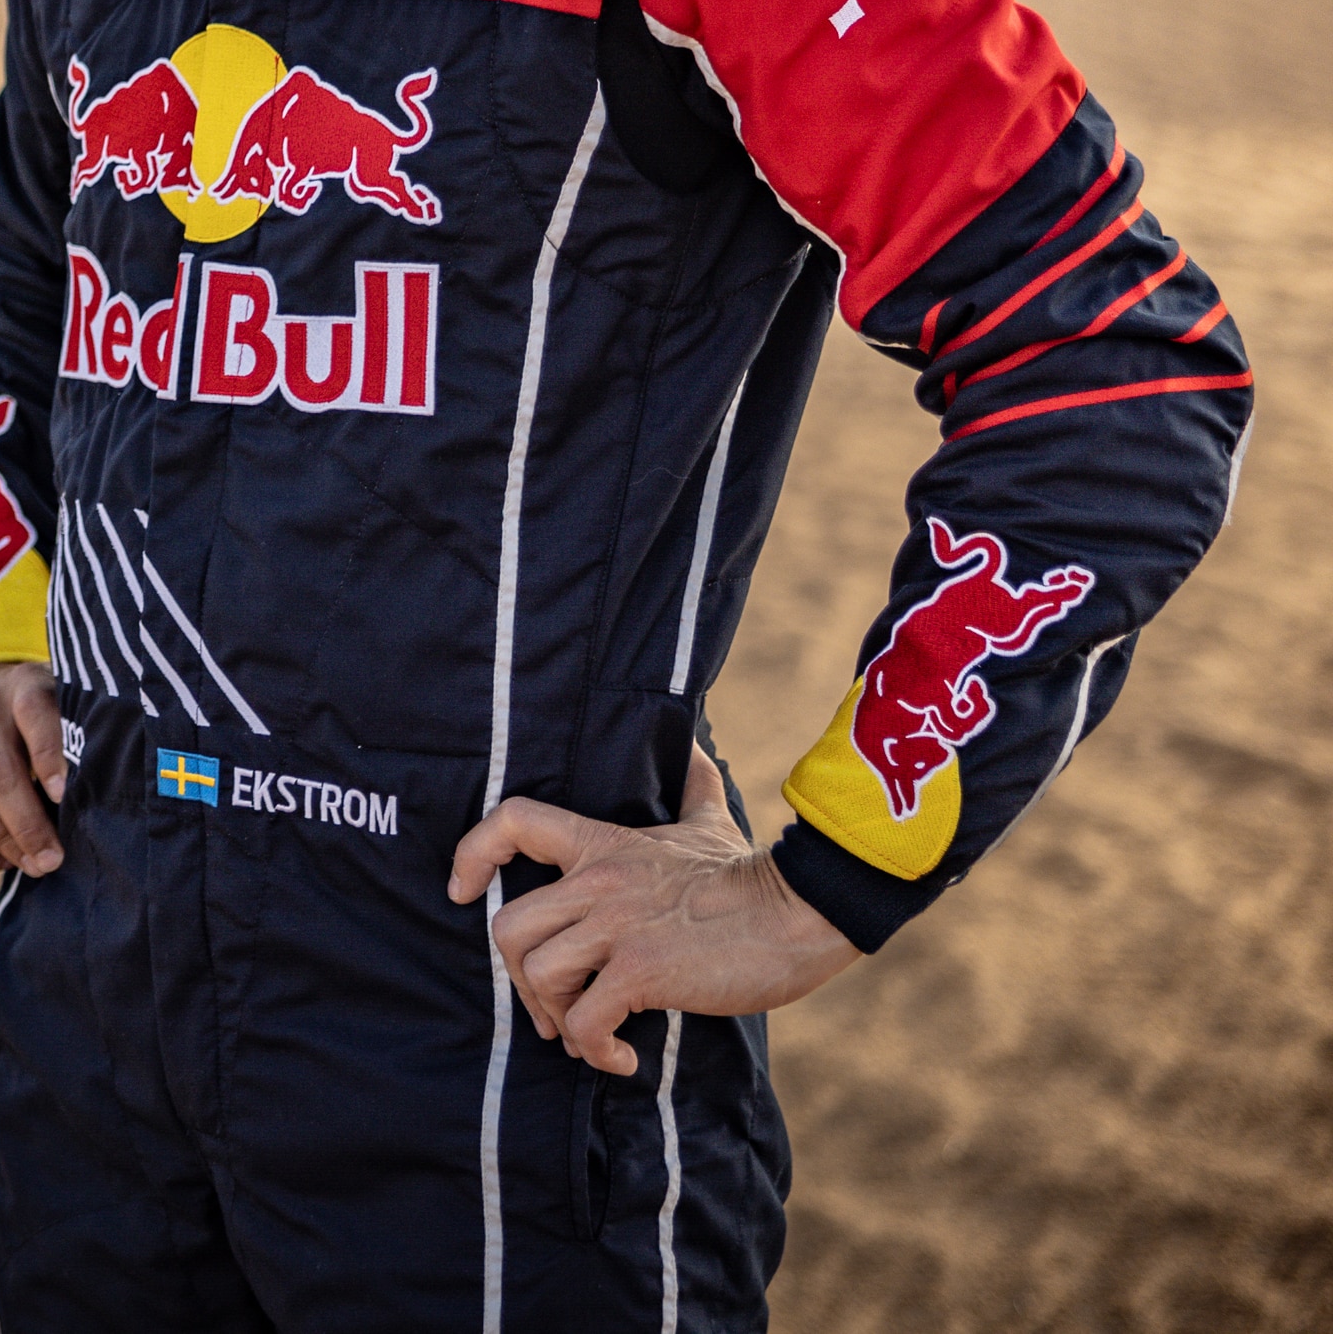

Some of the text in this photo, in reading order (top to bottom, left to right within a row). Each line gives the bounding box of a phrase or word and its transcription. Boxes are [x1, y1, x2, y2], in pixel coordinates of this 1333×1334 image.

[62, 246, 436, 413] Red Bull
[232, 767, 398, 836] EKSTROM
